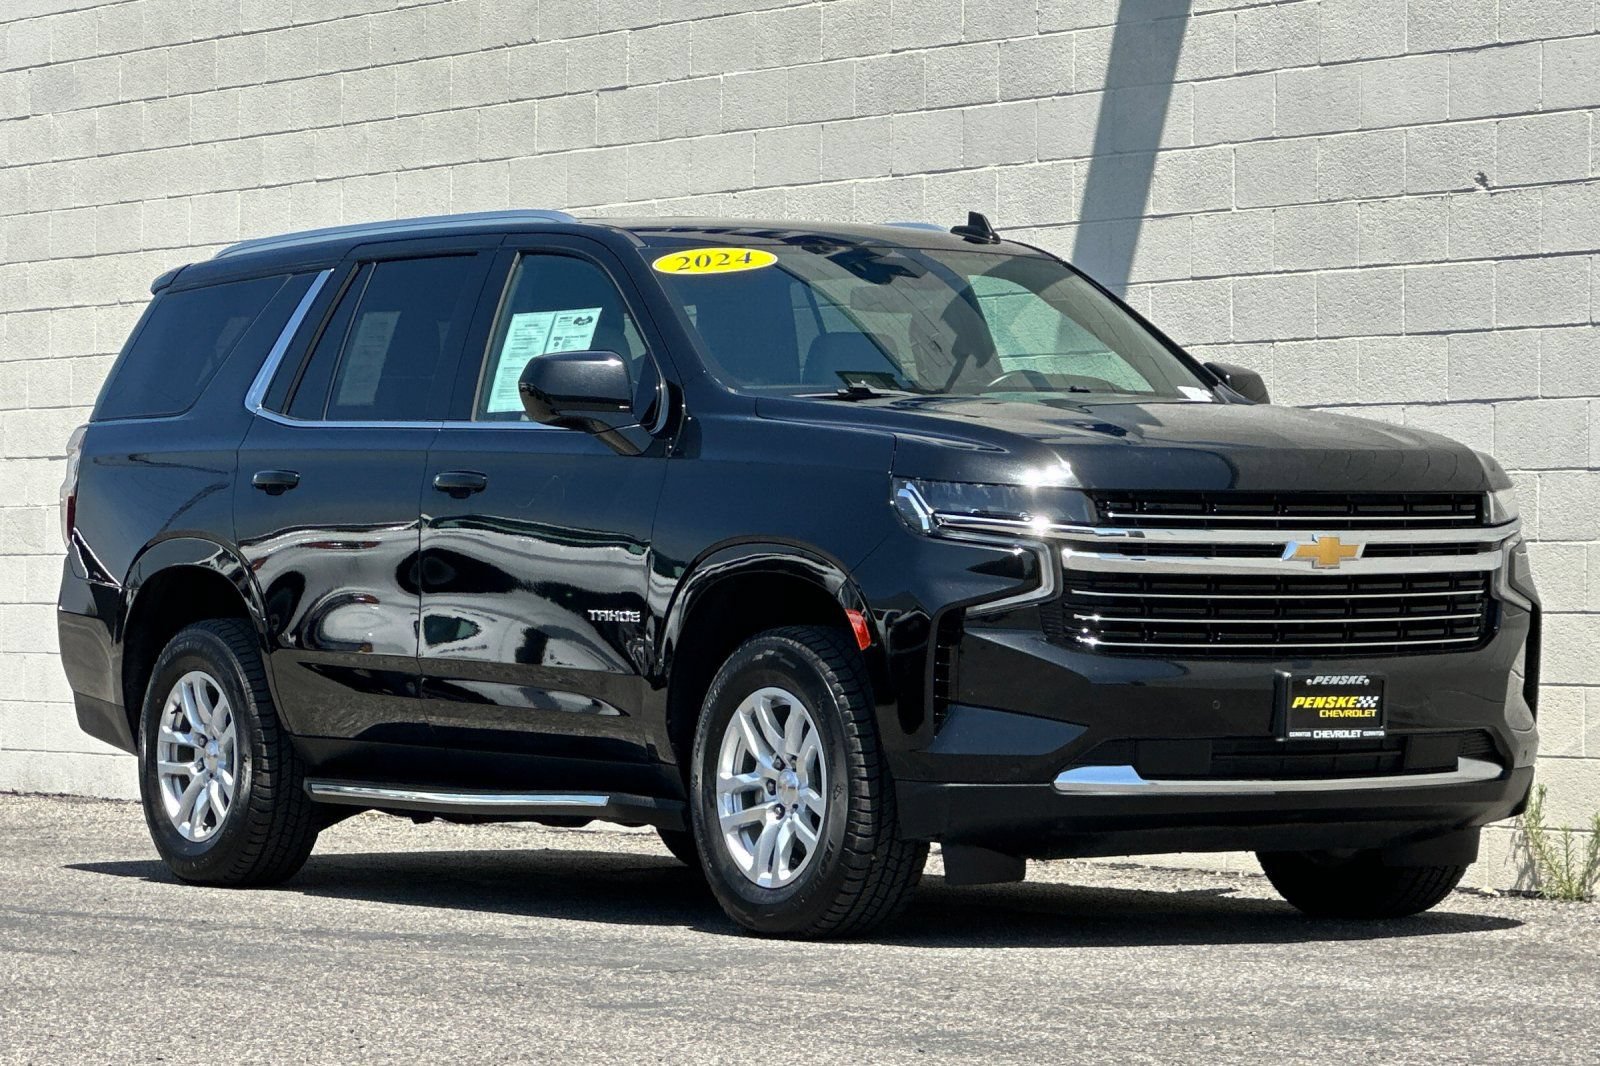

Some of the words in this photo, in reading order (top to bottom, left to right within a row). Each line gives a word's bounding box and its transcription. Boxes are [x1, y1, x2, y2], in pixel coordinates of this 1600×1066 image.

[677, 251, 752, 270] 2024
[587, 609, 640, 623] TAHOE
[1312, 675, 1367, 685] PENSKE
[1292, 696, 1358, 708] PENSKE
[1319, 709, 1376, 717] CHEVROLET
[1313, 730, 1361, 738] CHEVROLET
